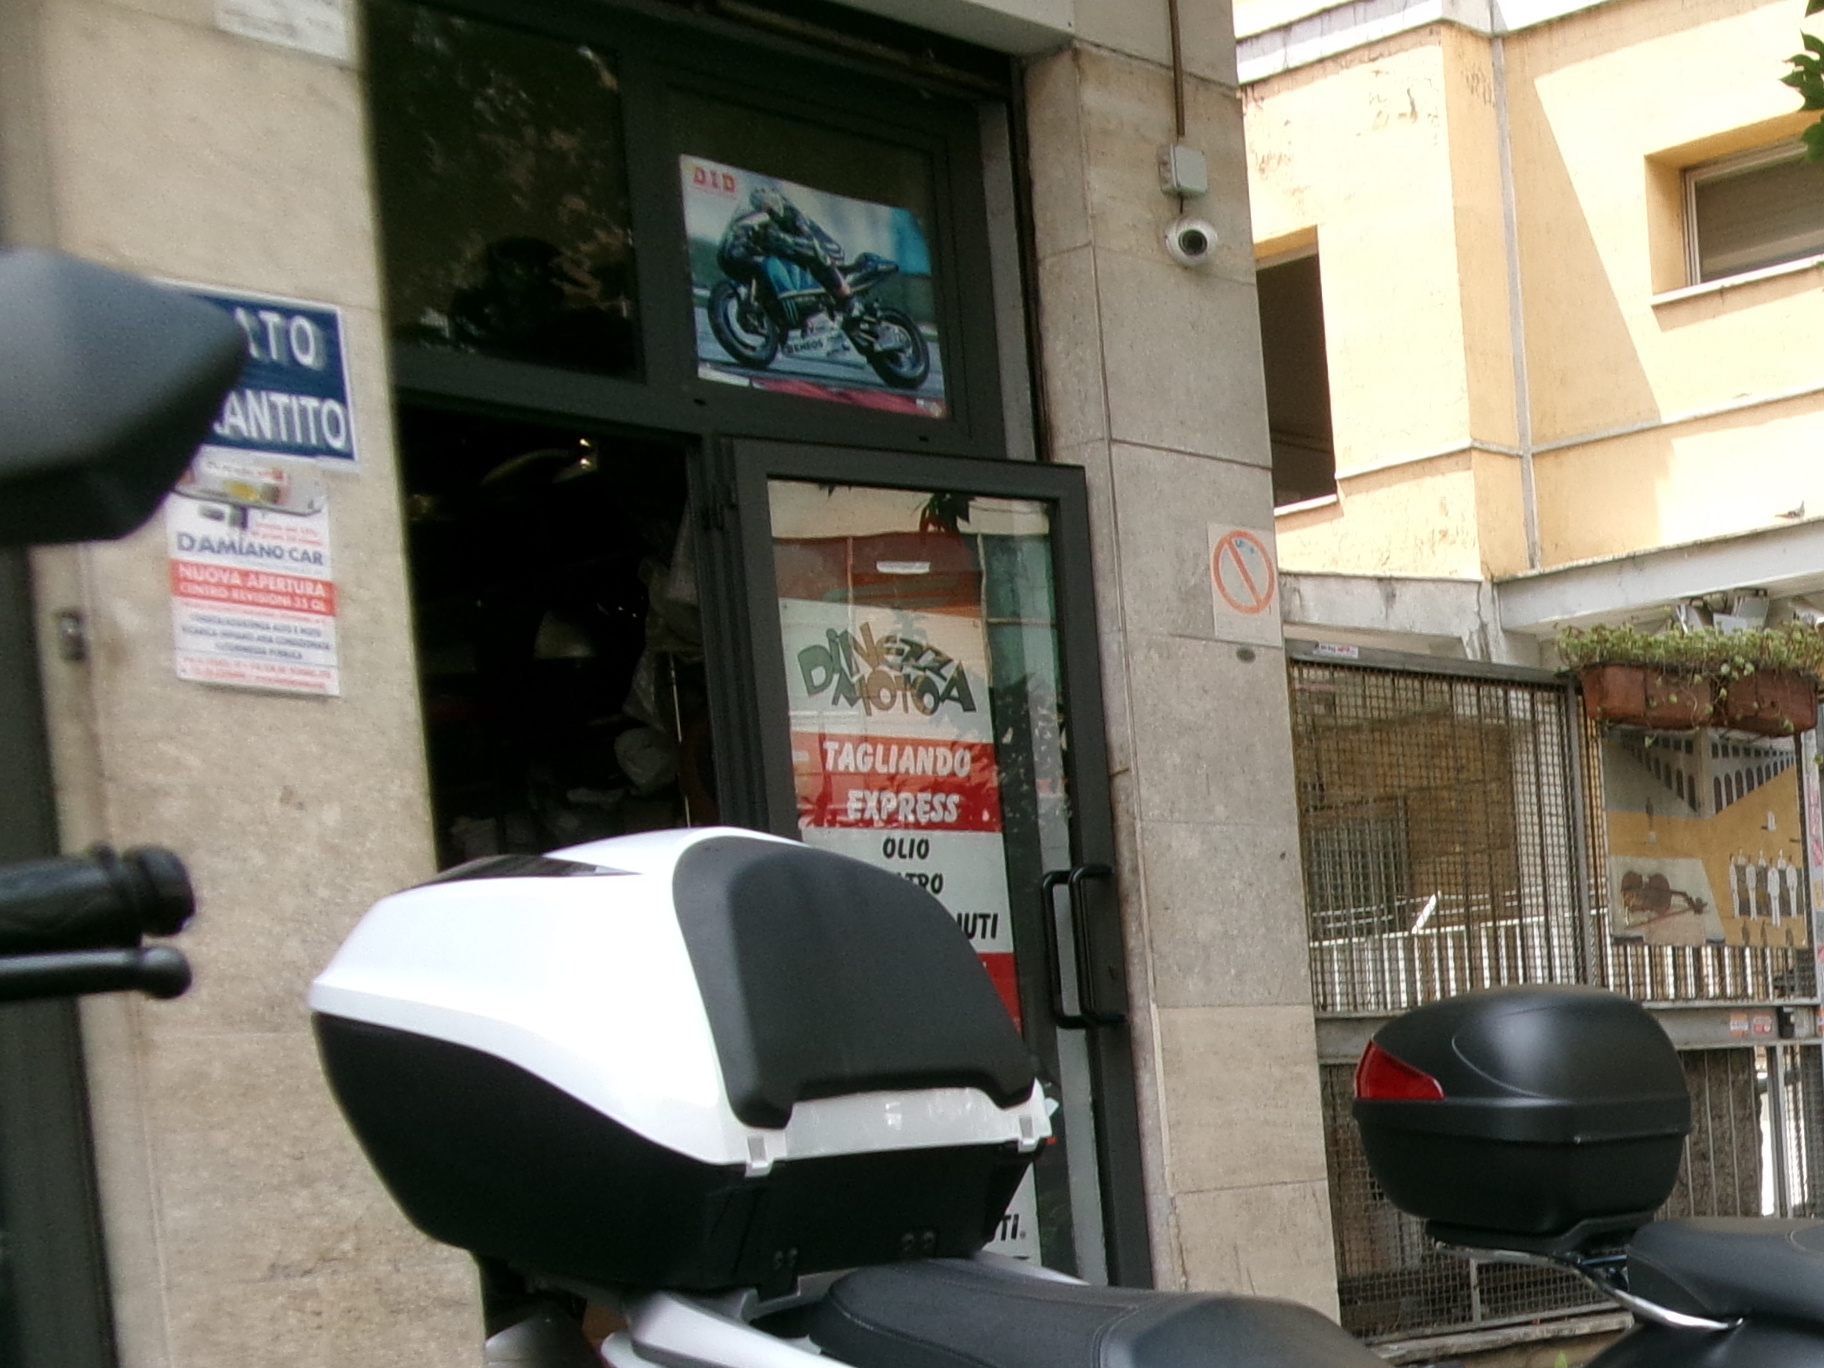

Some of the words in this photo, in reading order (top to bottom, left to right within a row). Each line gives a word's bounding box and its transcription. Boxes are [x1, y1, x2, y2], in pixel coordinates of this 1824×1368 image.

[212, 388, 347, 450] ANTITO
[176, 532, 284, 560] DAMIANO
[288, 549, 323, 566] CAR
[178, 563, 241, 585] NUOVA
[247, 574, 326, 597] APERTURA
[823, 741, 972, 777] TAGLIANDO
[847, 788, 960, 823] EXPRESS
[882, 837, 930, 860] OLIO
